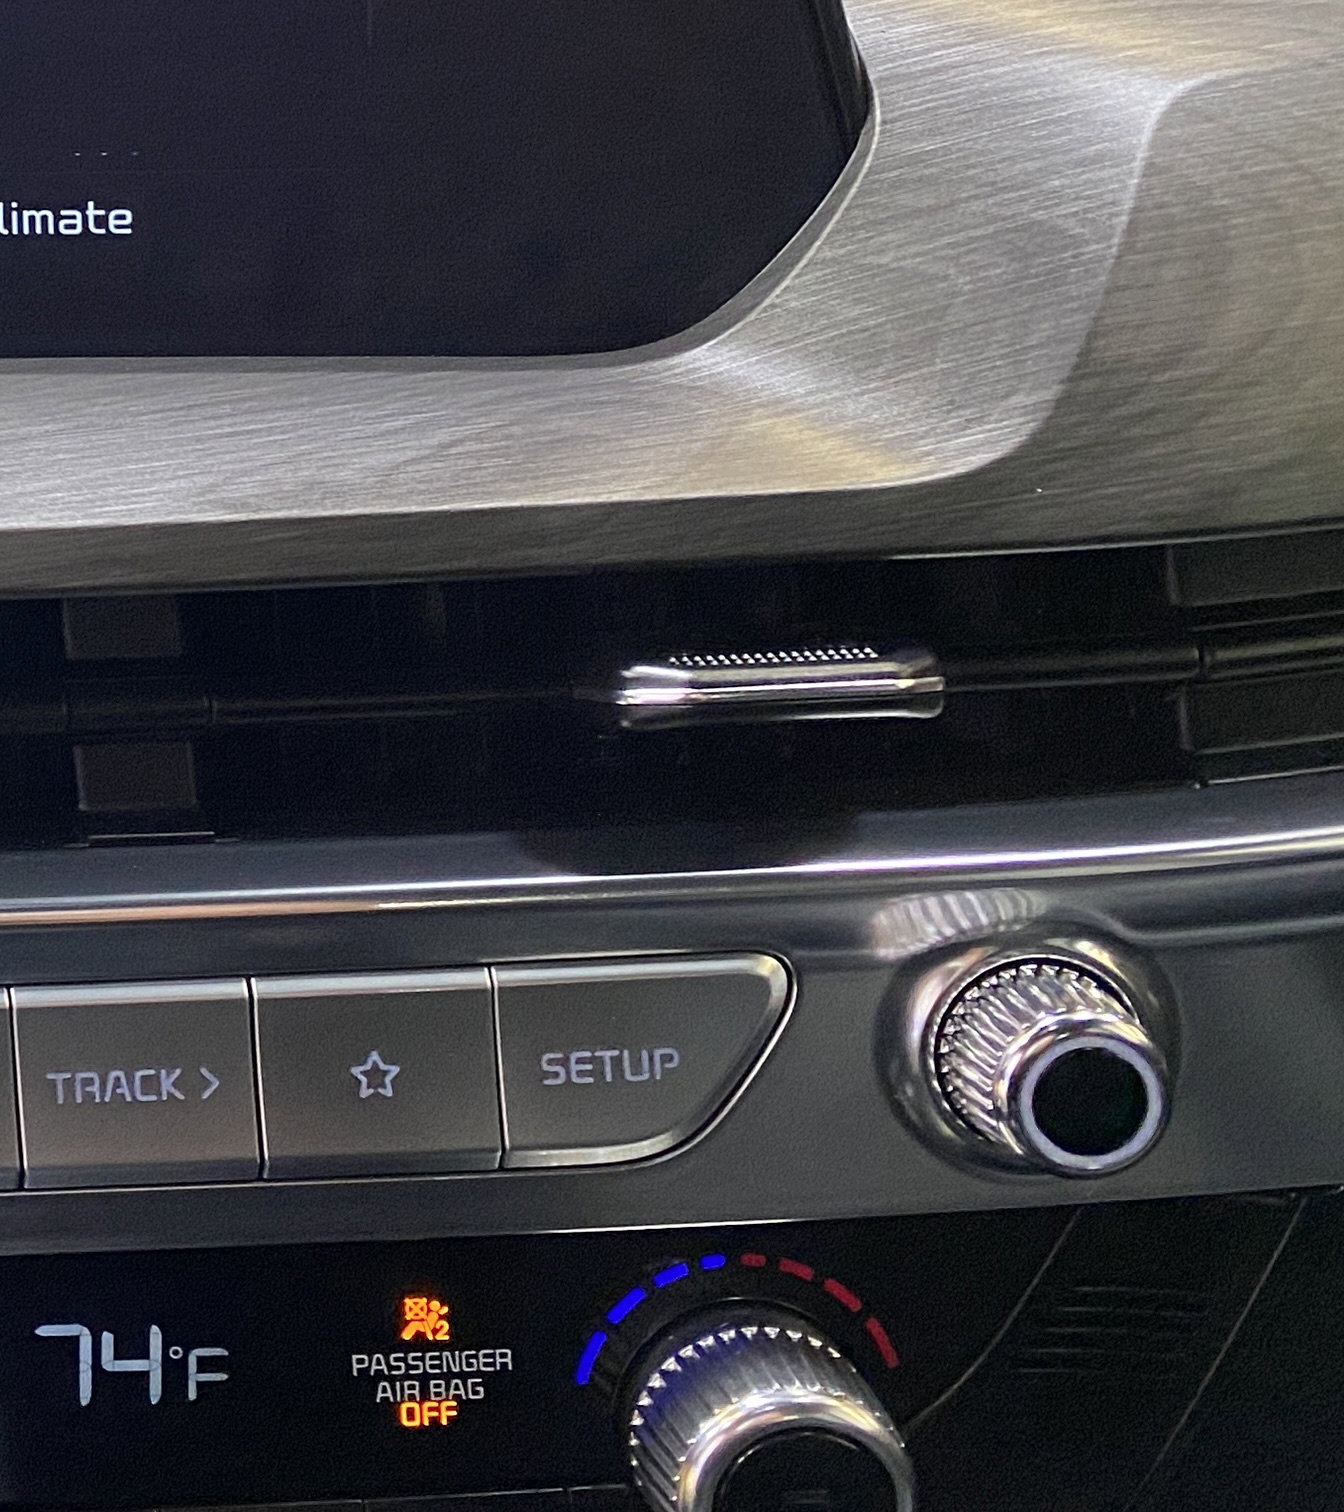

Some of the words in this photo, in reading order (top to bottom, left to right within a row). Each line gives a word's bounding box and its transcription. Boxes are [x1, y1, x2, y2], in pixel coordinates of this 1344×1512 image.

[541, 1048, 679, 1085] SETUP
[46, 1068, 185, 1104] TRACK
[351, 1348, 513, 1377] PASSENGER
[376, 1381, 420, 1403] AIR
[429, 1378, 485, 1400] BAG
[399, 1400, 458, 1427] OFF
